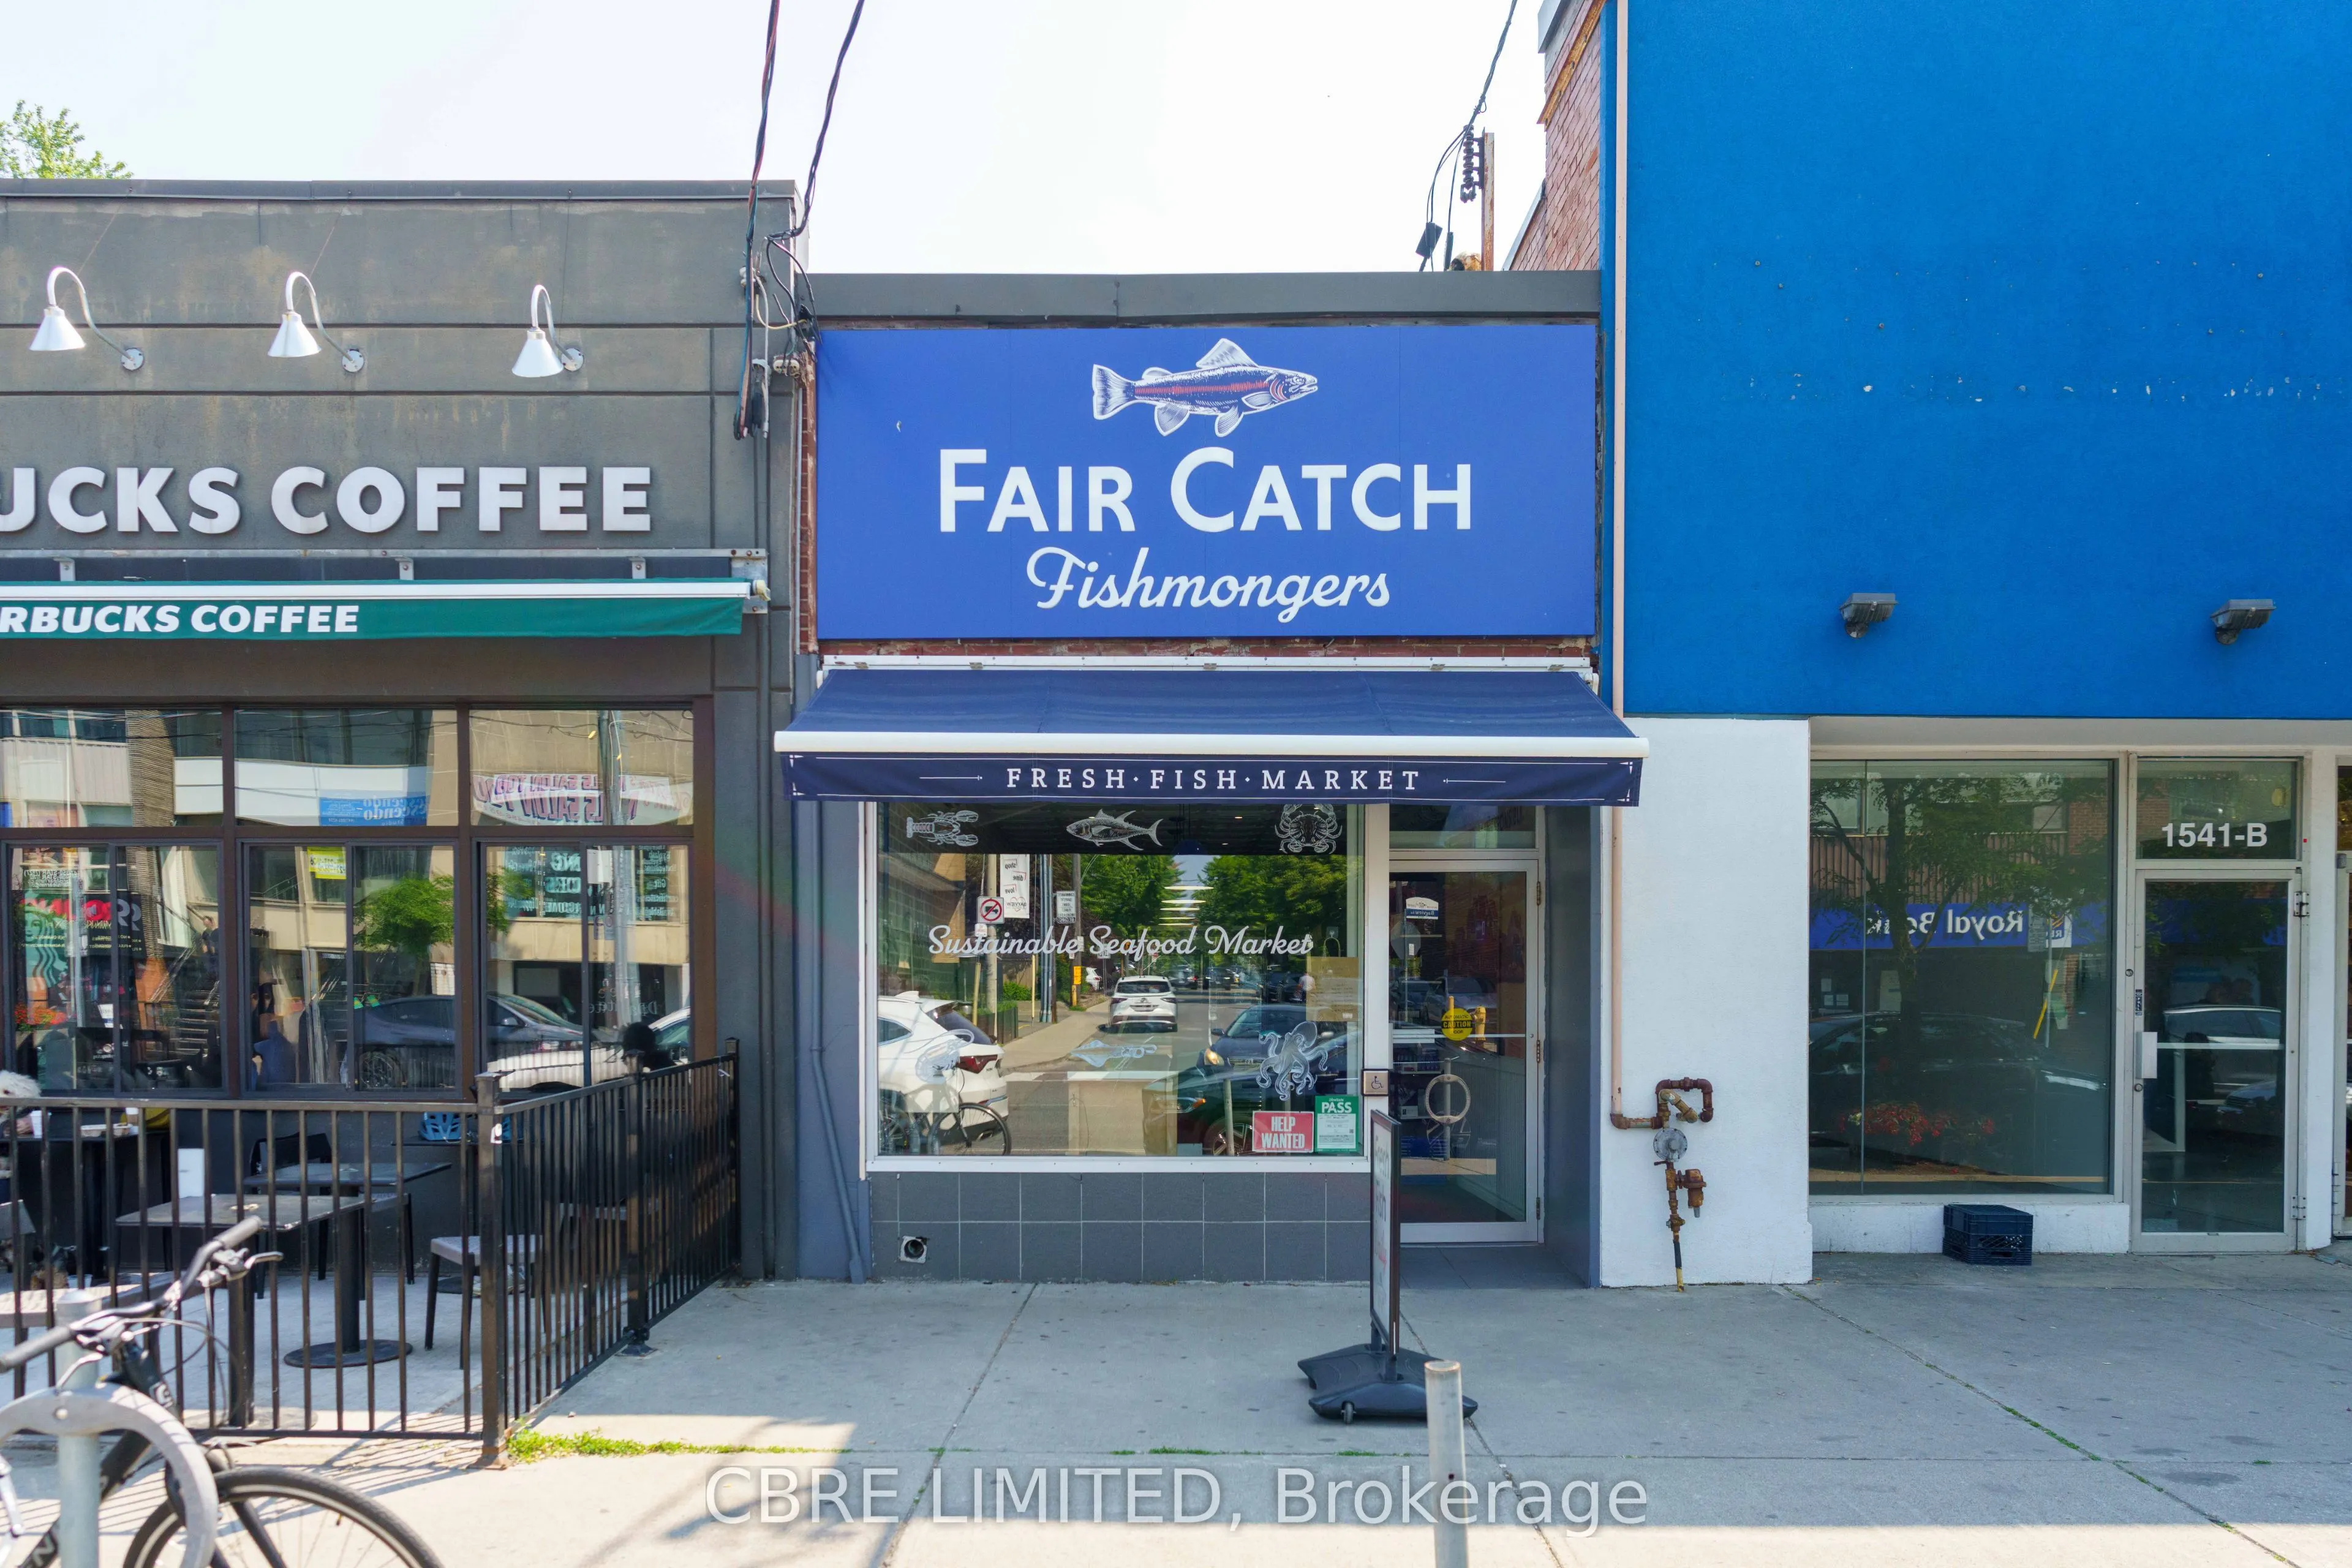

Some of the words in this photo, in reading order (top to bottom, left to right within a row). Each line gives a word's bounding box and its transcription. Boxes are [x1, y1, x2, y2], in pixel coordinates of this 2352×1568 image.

[271, 466, 651, 534] COFFEE
[940, 449, 1136, 533] FAIR
[1170, 447, 1471, 533] CATCH
[1027, 546, 1390, 624] Fishmongers
[190, 605, 359, 633] COFFEE
[1007, 768, 1125, 789] FRESH
[1150, 769, 1236, 790] FISH
[1262, 770, 1419, 790] MARKET
[2162, 823, 2267, 847] 1541-B
[929, 925, 1079, 955] Sustainable
[1089, 925, 1197, 959] Seafood
[1205, 925, 1313, 955] Market
[1321, 1102, 1352, 1114] PASS
[1272, 1116, 1296, 1132] HELP
[1262, 1133, 1305, 1149] WANTED
